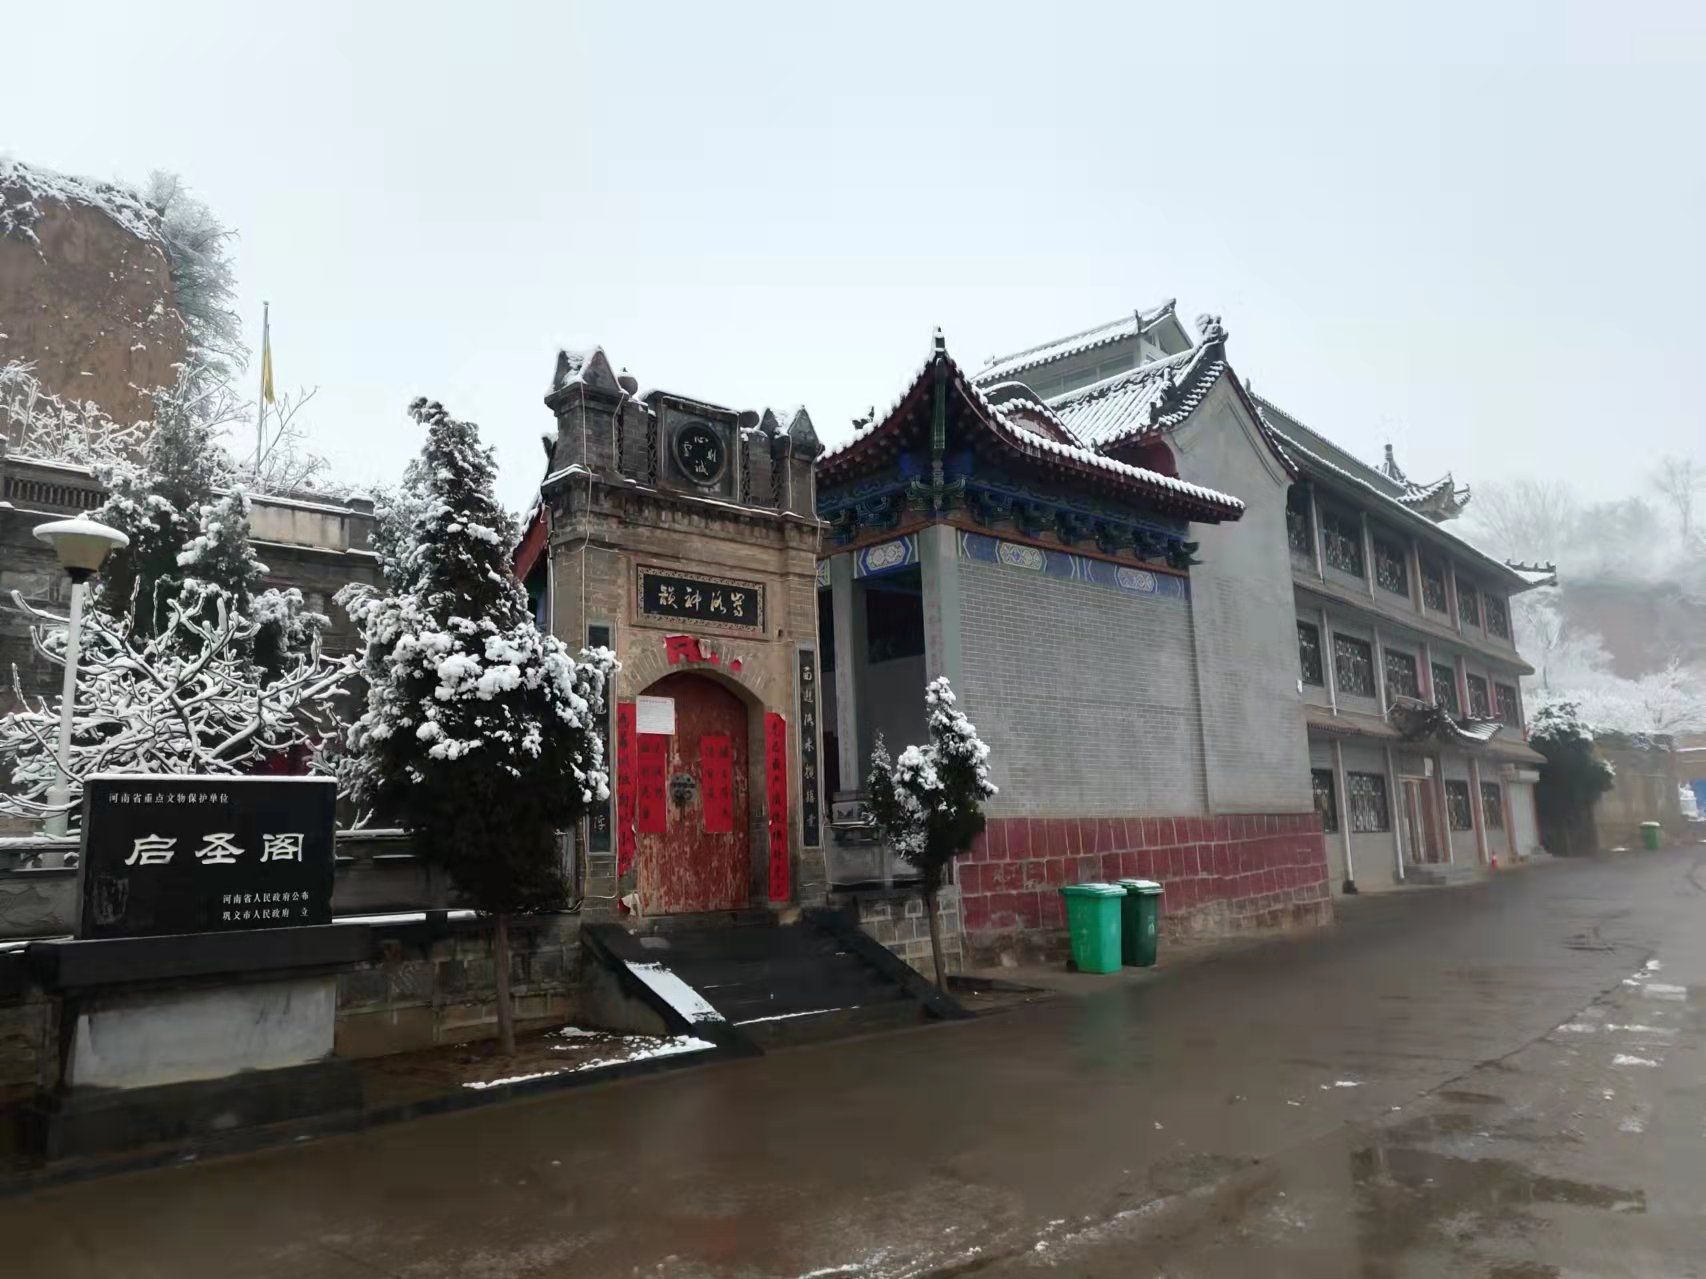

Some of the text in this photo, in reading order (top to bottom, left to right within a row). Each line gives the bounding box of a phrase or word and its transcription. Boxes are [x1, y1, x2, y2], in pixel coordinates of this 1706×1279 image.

[108, 792, 229, 804] 河南省重点文物保护单位
[124, 832, 305, 866] 启圣阁
[222, 891, 309, 905] 河南省人民政府公布
[222, 908, 290, 921] 巩义市人民政府
